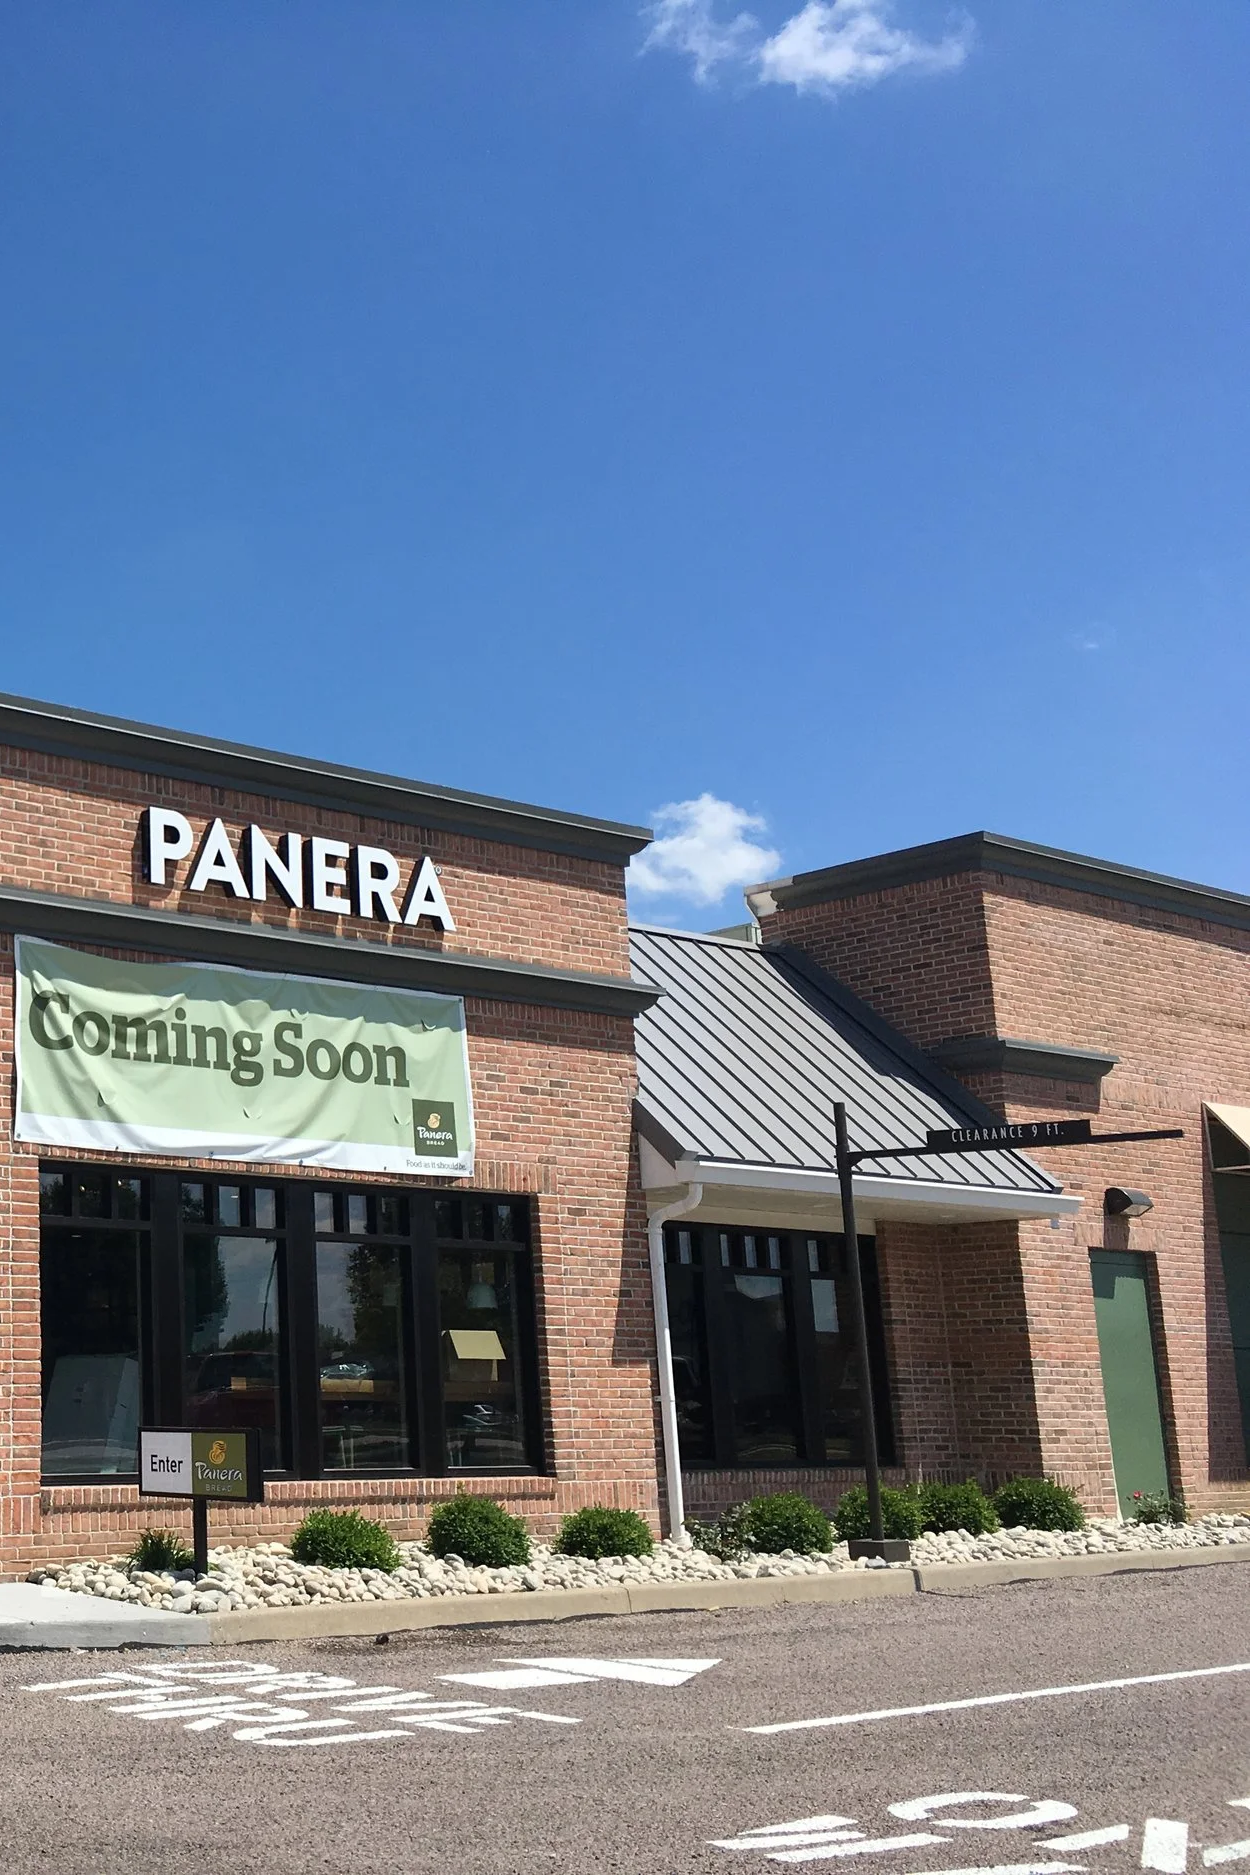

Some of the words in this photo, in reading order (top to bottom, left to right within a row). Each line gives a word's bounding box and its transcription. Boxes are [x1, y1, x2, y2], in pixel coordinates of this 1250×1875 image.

[147, 806, 456, 931] PANERA
[28, 989, 264, 1087] Coming
[273, 1021, 410, 1088] Soon
[416, 1126, 453, 1140] Panera
[951, 1125, 1023, 1143] CLEARANCE
[1031, 1124, 1039, 1137] 9
[1046, 1123, 1065, 1136] FT.
[406, 1159, 422, 1168] Food
[436, 1161, 458, 1170] should
[150, 1454, 184, 1474] Enter
[195, 1462, 243, 1482] Panera
[205, 1483, 232, 1492] BREAD
[133, 1661, 584, 1733] DRIVE
[20, 1670, 416, 1747] THRU
